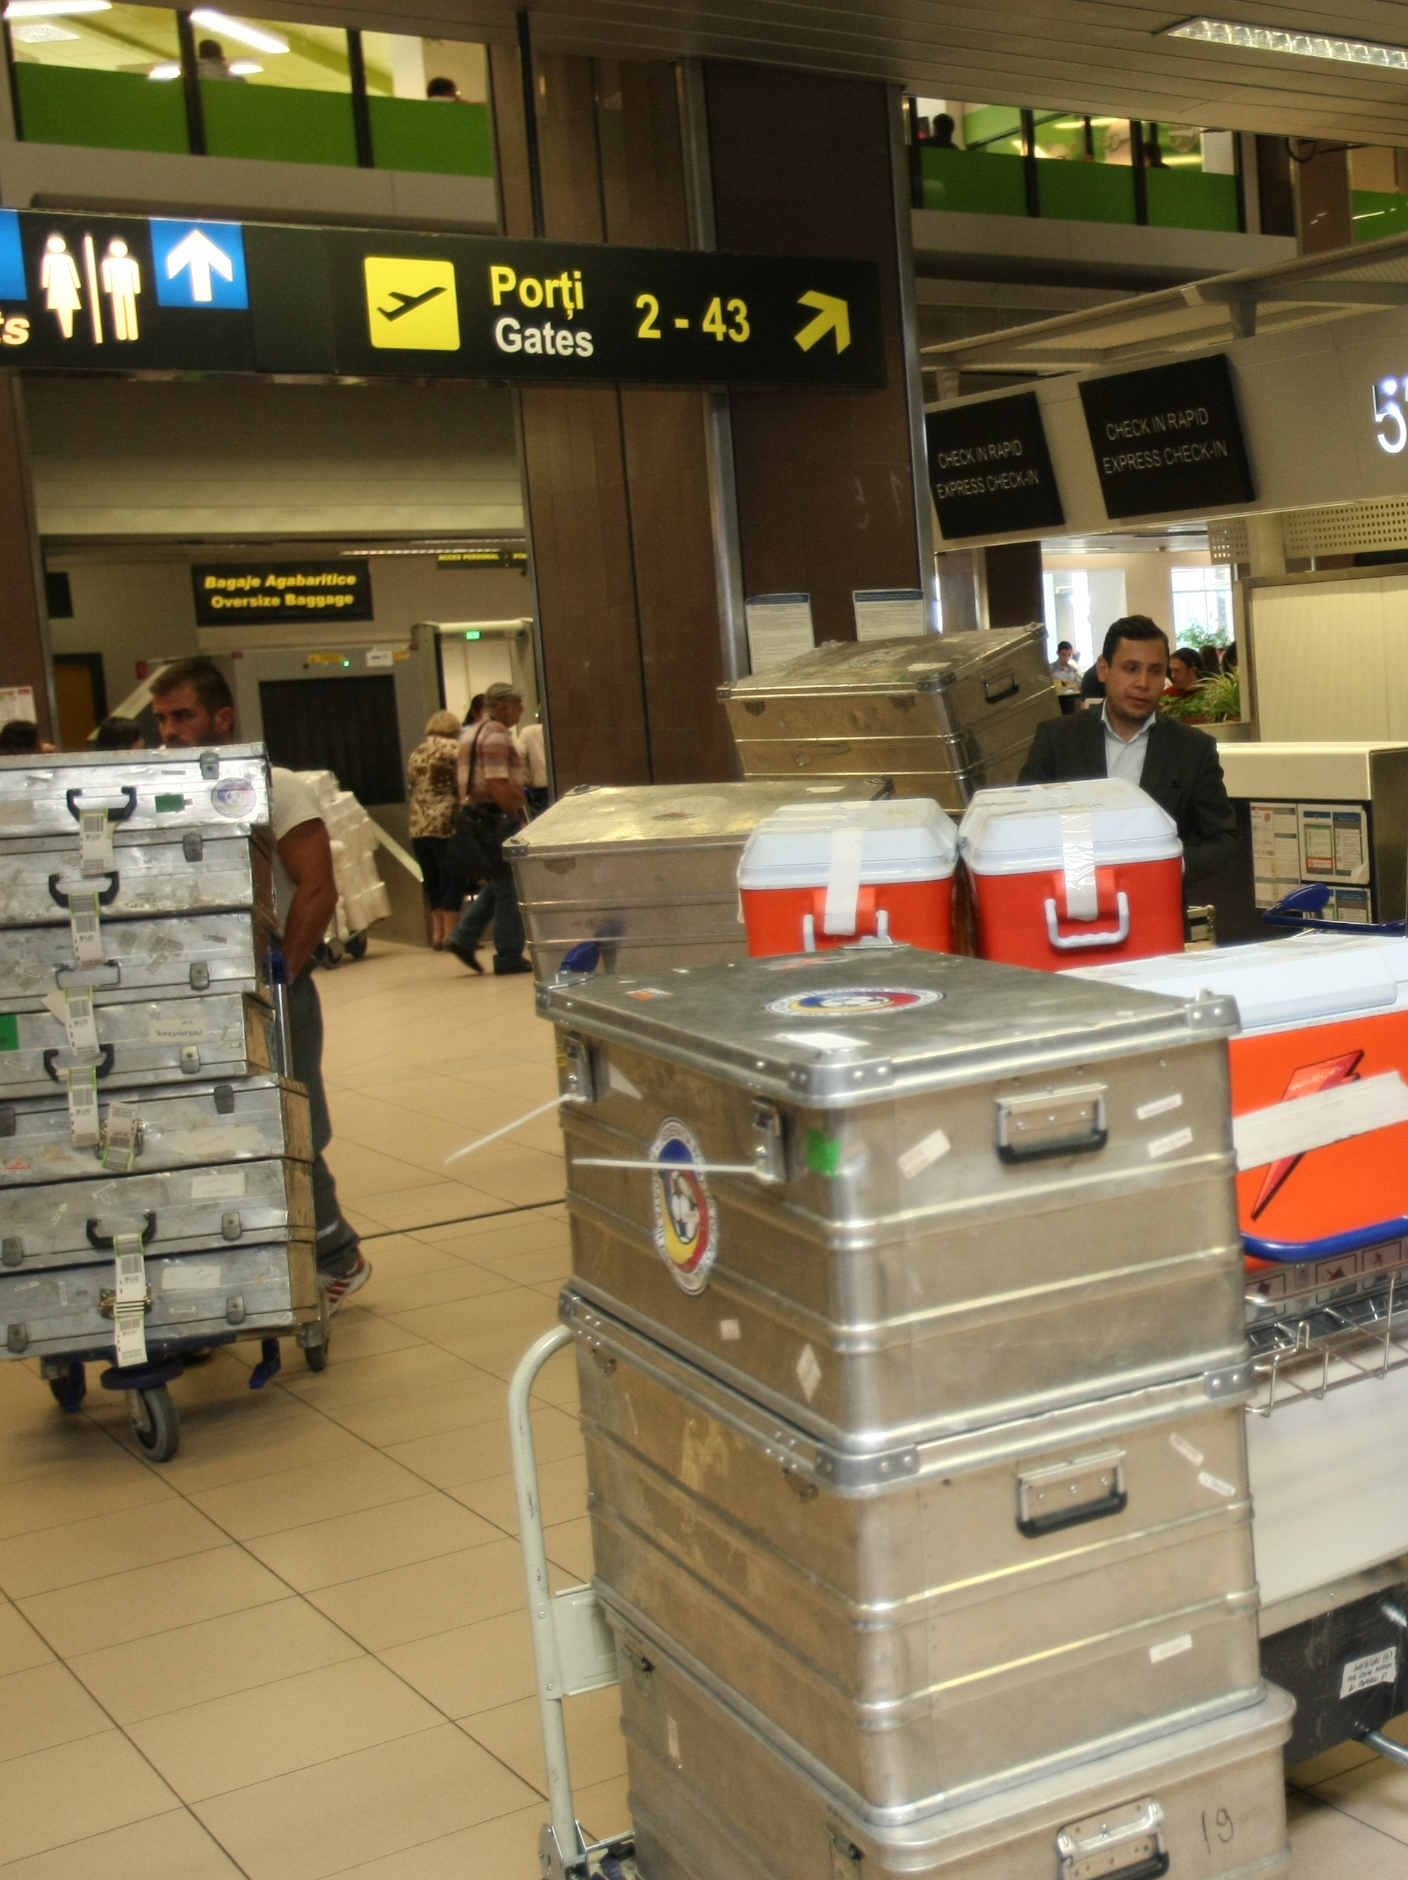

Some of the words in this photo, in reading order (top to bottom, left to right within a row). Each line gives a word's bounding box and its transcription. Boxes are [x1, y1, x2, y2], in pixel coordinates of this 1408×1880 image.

[0, 310, 31, 346] s
[636, 293, 662, 339] 2
[702, 297, 750, 343] 43
[494, 317, 594, 357] Gates
[1106, 417, 1151, 441] CHECK
[1151, 415, 1167, 433] IN
[1167, 407, 1209, 431] RAPID
[938, 448, 975, 469] CHECK
[975, 445, 989, 463] IN
[989, 439, 1023, 461] RAPID
[1103, 449, 1162, 475] EXPRESS
[1164, 439, 1228, 466] CHECK-IN
[937, 477, 986, 500] EXPRESS
[986, 469, 1040, 492] CHECK-IN
[204, 575, 262, 592] Bagaje
[265, 573, 356, 590] Agabaritice
[211, 594, 281, 608] Oversize
[285, 593, 354, 608] Baggage
[1201, 1807, 1234, 1855] 19
